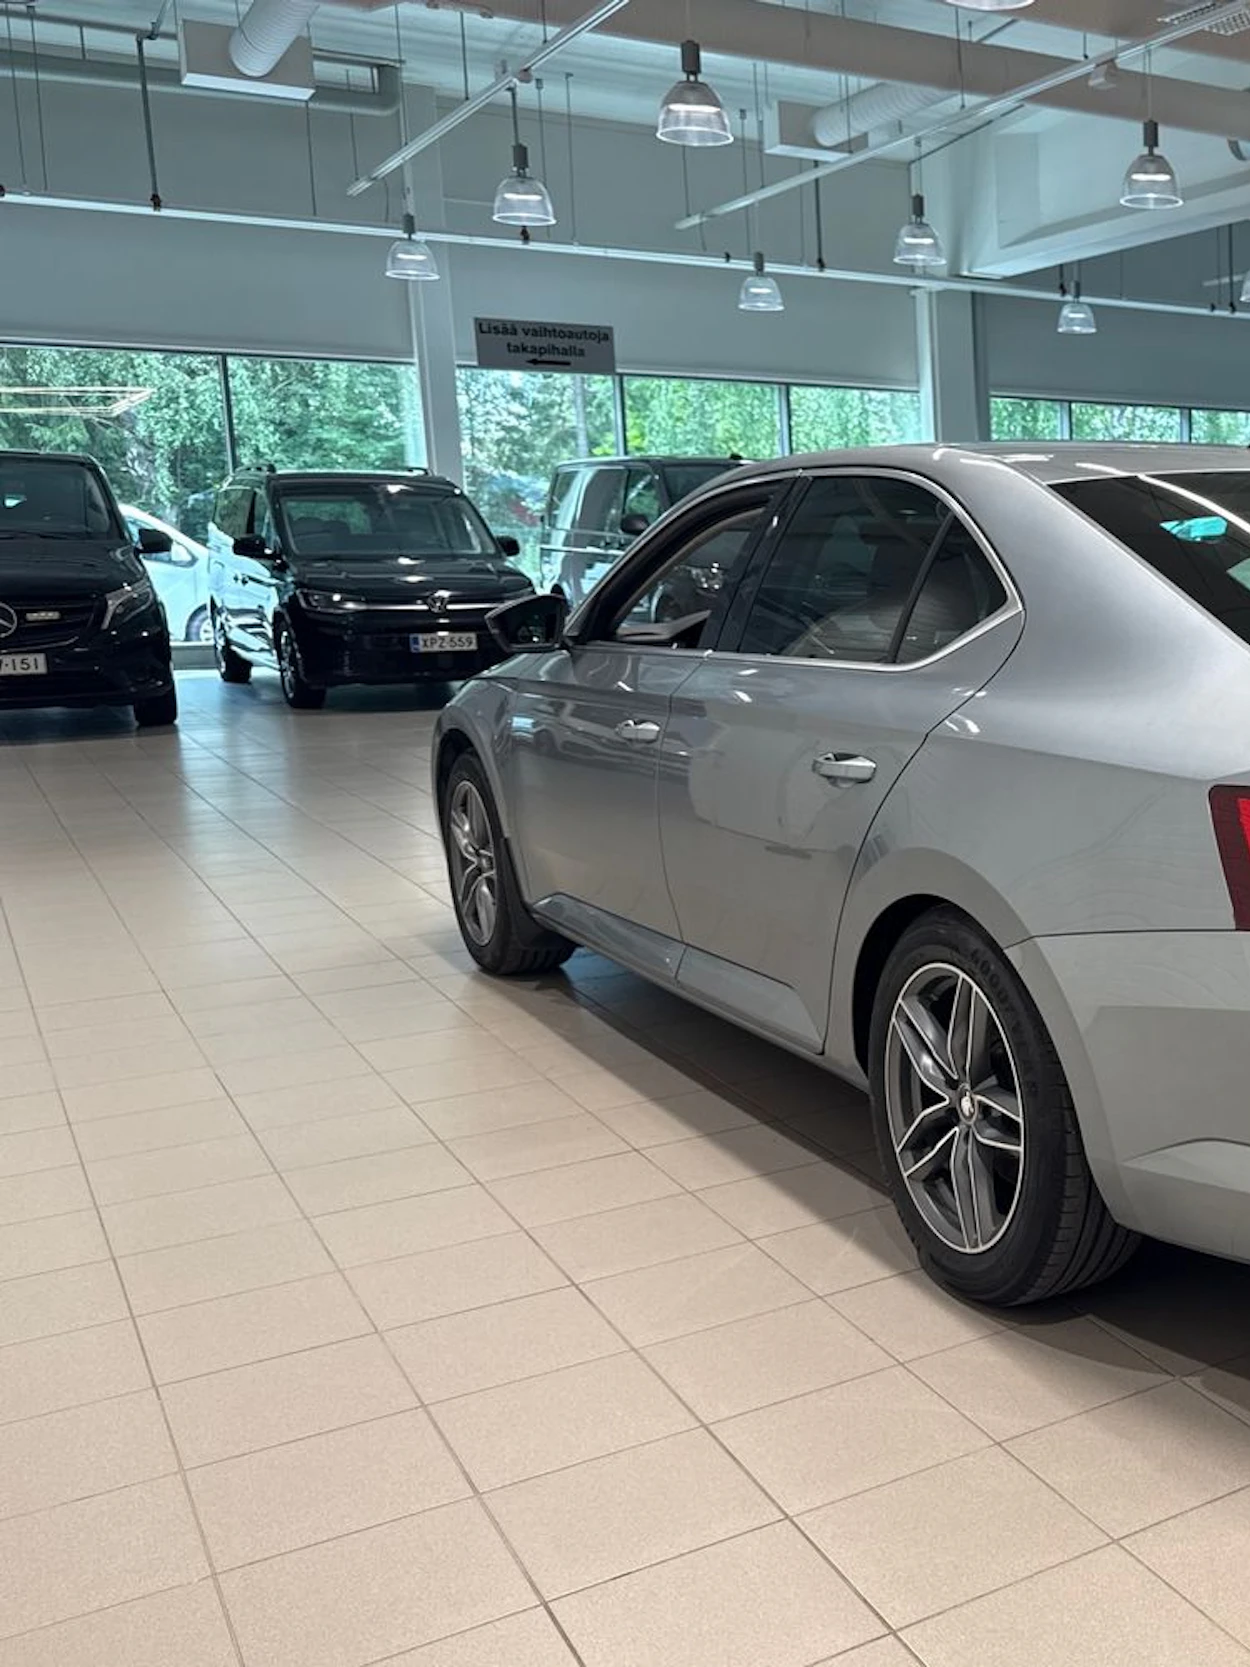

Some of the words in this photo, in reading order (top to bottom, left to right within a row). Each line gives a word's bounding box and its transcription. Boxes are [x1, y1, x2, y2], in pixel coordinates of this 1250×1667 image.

[479, 322, 517, 336] Lisää
[522, 327, 609, 343] vaihtoautoja
[507, 342, 586, 357] takapihalla
[0, 657, 38, 671] -151
